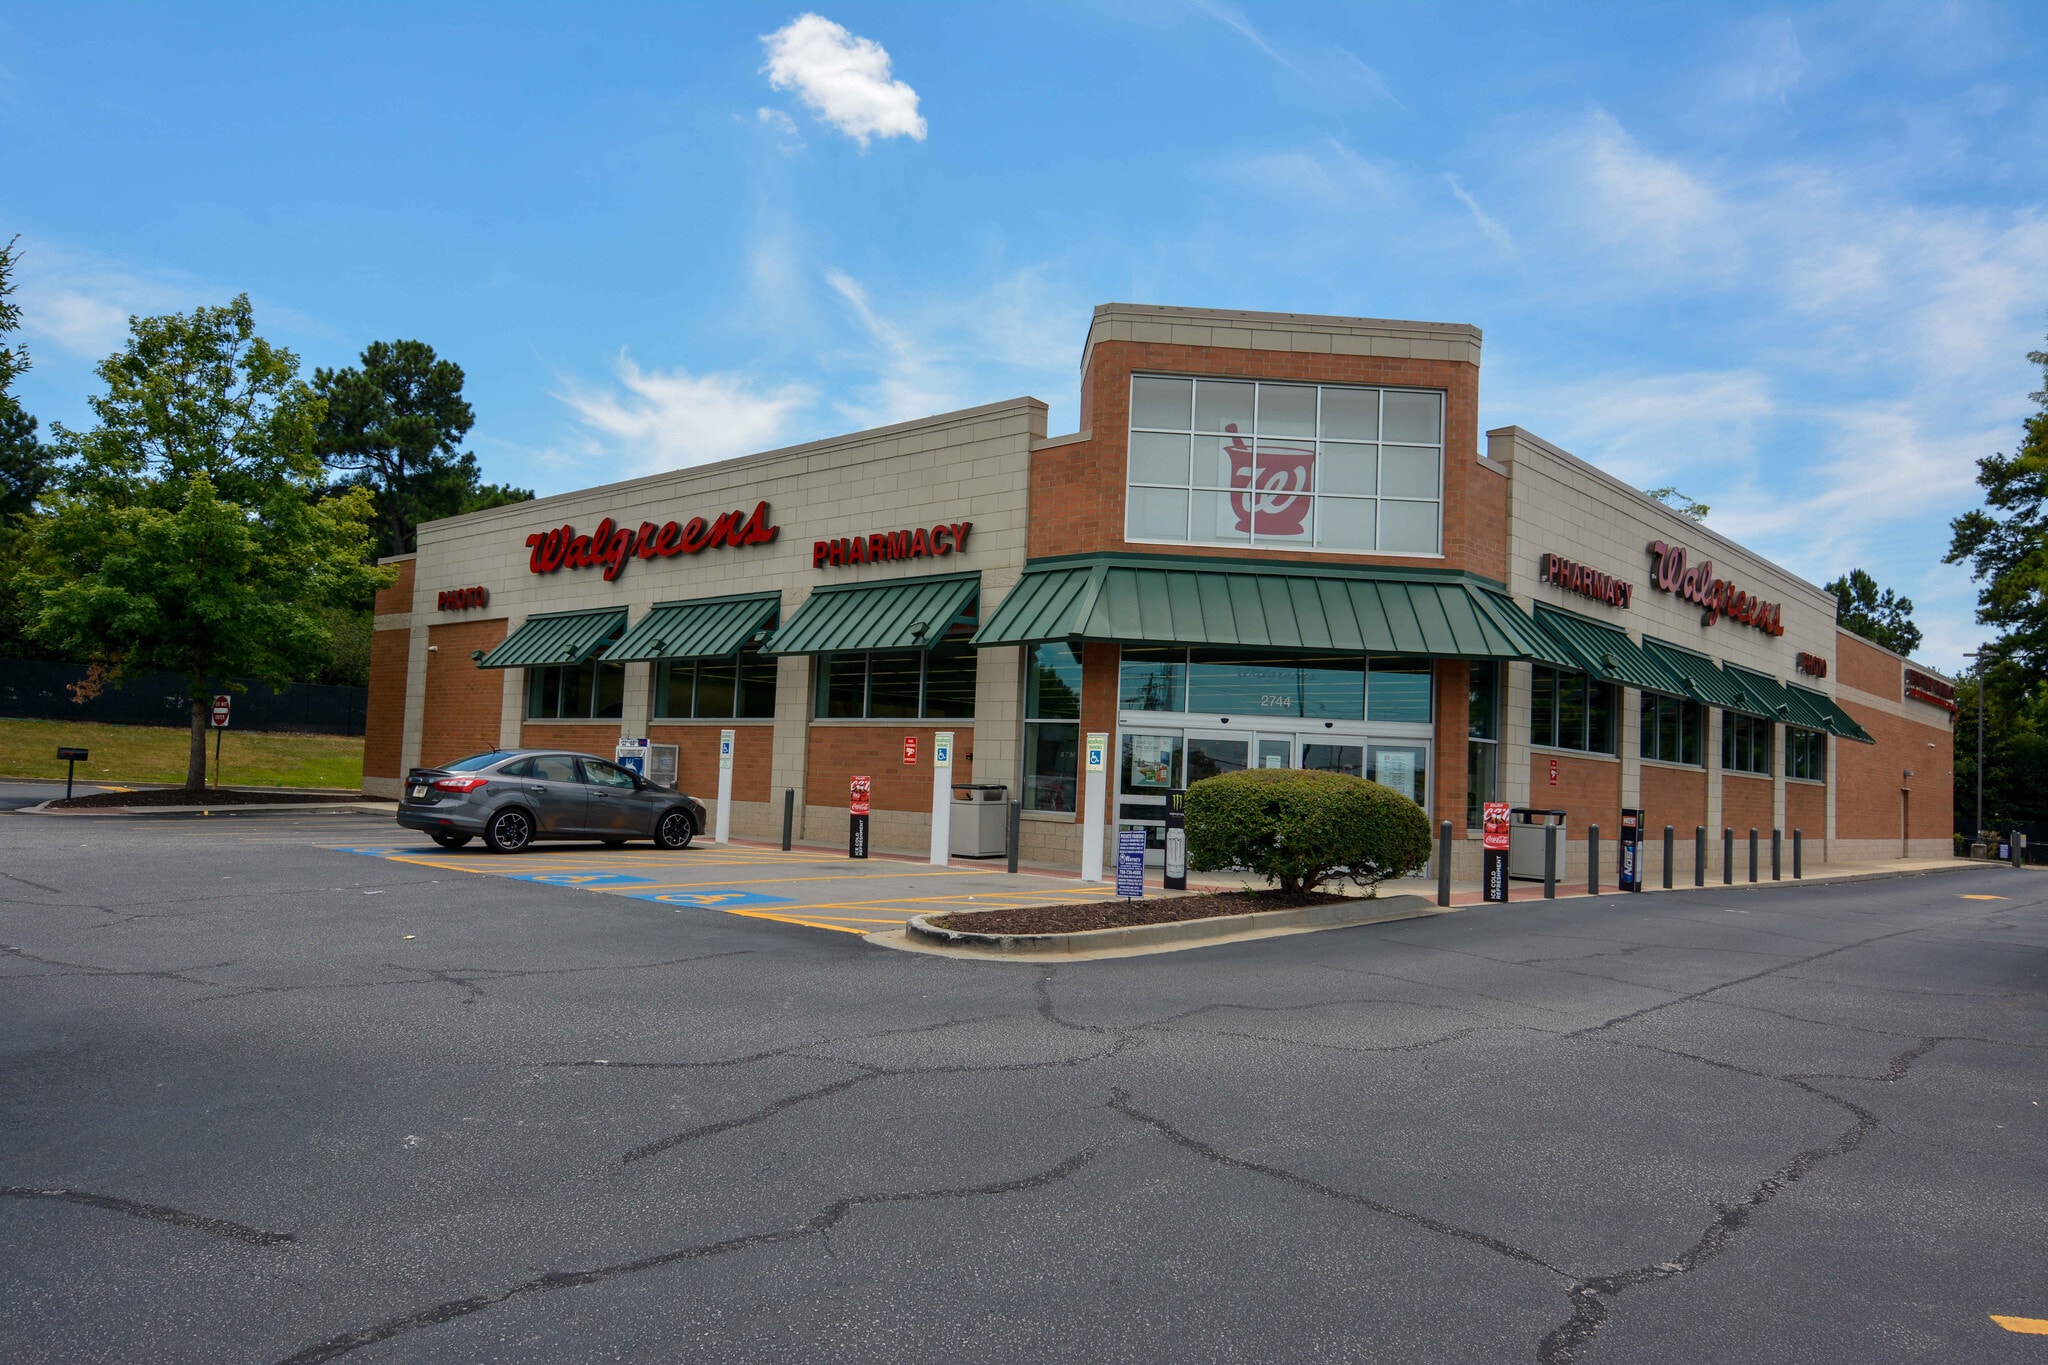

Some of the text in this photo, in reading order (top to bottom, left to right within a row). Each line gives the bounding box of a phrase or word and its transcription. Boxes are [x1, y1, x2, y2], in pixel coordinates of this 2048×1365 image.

[525, 500, 780, 582] Walgreens
[813, 521, 973, 569] PHARMACY
[1542, 553, 1634, 610] PHARMACY
[1648, 540, 1784, 637] Walgreens
[437, 585, 489, 611] PHOTO
[1800, 651, 1828, 679] PHOTO
[1261, 695, 1291, 708] 2744
[1485, 835, 1508, 845] Coca-Cola
[1623, 846, 1633, 876] NOS
